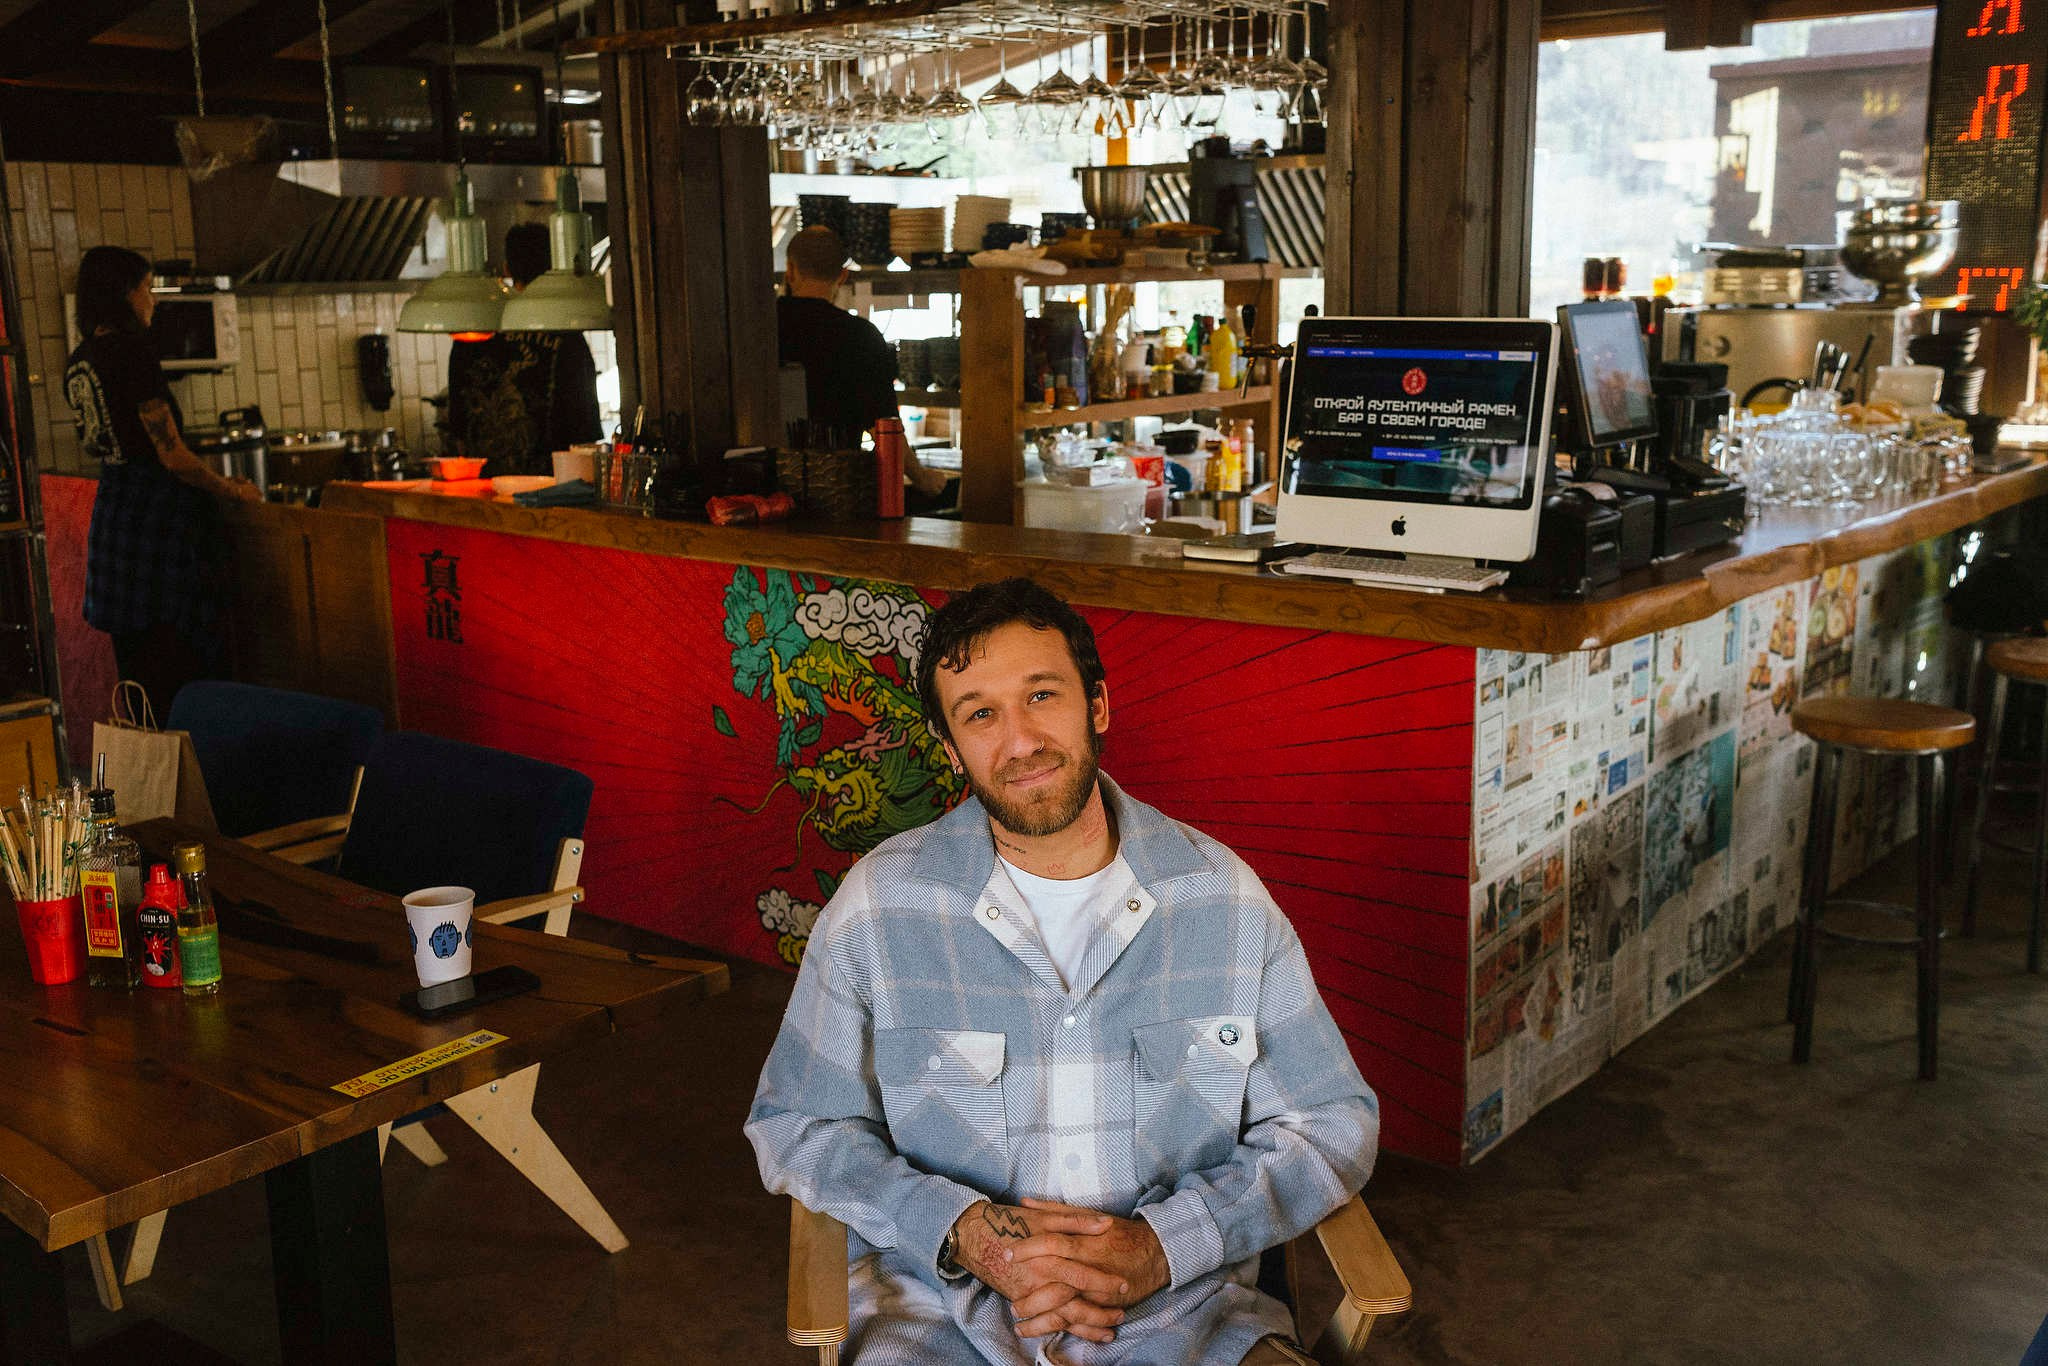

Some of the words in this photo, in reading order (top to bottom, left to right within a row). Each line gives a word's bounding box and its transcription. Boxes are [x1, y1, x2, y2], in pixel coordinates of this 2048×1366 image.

[1314, 396, 1364, 410] ОТКРОЙ
[1367, 399, 1465, 414] АУТЕНТИЧНЫЙ
[1468, 403, 1516, 416] РАМЕН
[1338, 412, 1364, 424] БАР
[1367, 413, 1377, 425] В
[1380, 414, 1427, 427] СВОЕМ
[1429, 415, 1487, 431] ГОРОДЕ!
